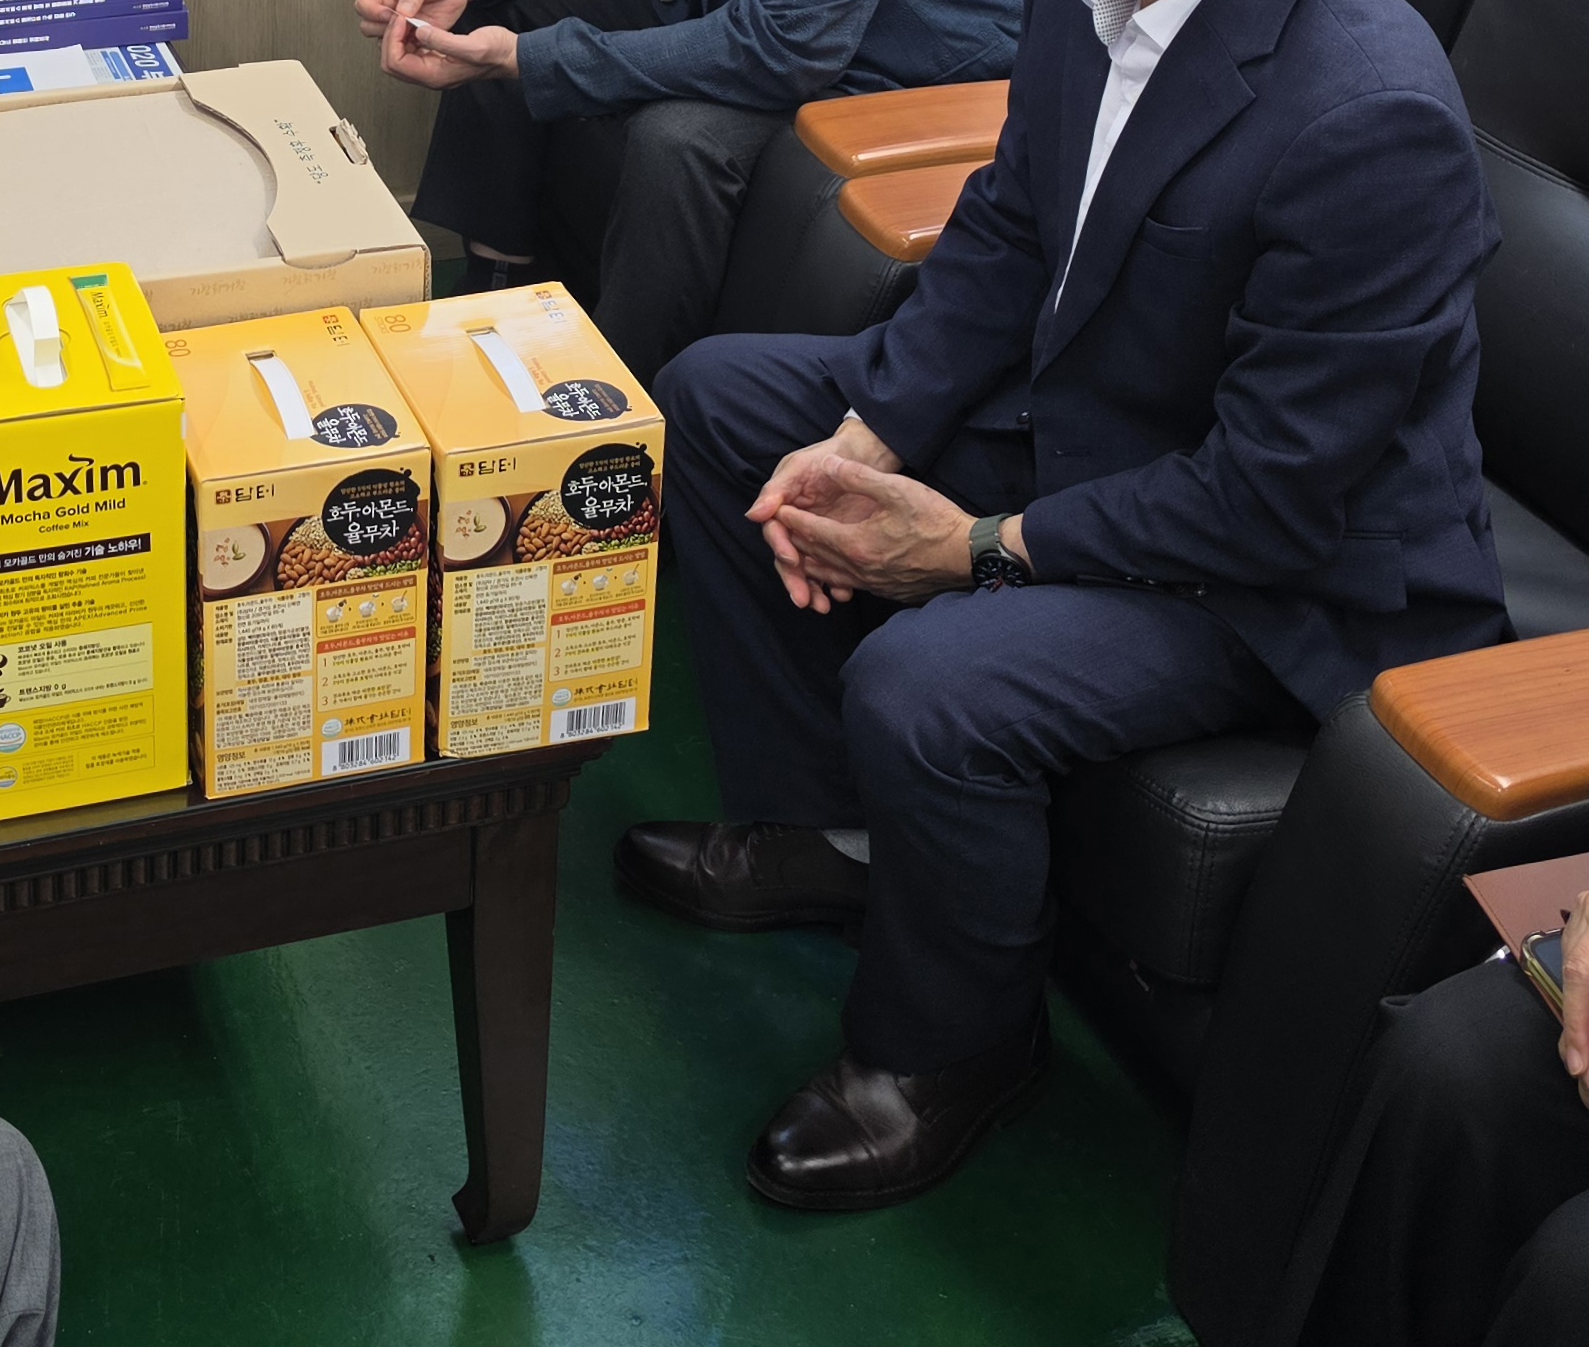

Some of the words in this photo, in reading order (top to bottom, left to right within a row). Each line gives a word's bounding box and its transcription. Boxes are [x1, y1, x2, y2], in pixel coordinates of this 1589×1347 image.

[90, 290, 109, 320] Maxim
[385, 314, 411, 334] 80
[165, 339, 191, 358] 80
[0, 509, 51, 526] Mocha
[55, 502, 90, 519] Gold
[94, 497, 126, 513] Mild
[580, 494, 635, 520] 율무차
[38, 522, 71, 534] Coffee
[72, 519, 90, 529] Mix
[343, 519, 400, 545] 율무차
[3, 556, 38, 568] 모카골드
[38, 552, 56, 563] 만의
[57, 548, 83, 561] 숨겨진
[84, 544, 105, 558] 기술
[107, 537, 142, 554] 노하우!
[17, 643, 38, 654] 코코넛
[38, 641, 53, 650] 오일
[54, 639, 67, 648] 사용
[19, 683, 52, 696] 트랜스지방
[216, 751, 246, 763] 영양정보
